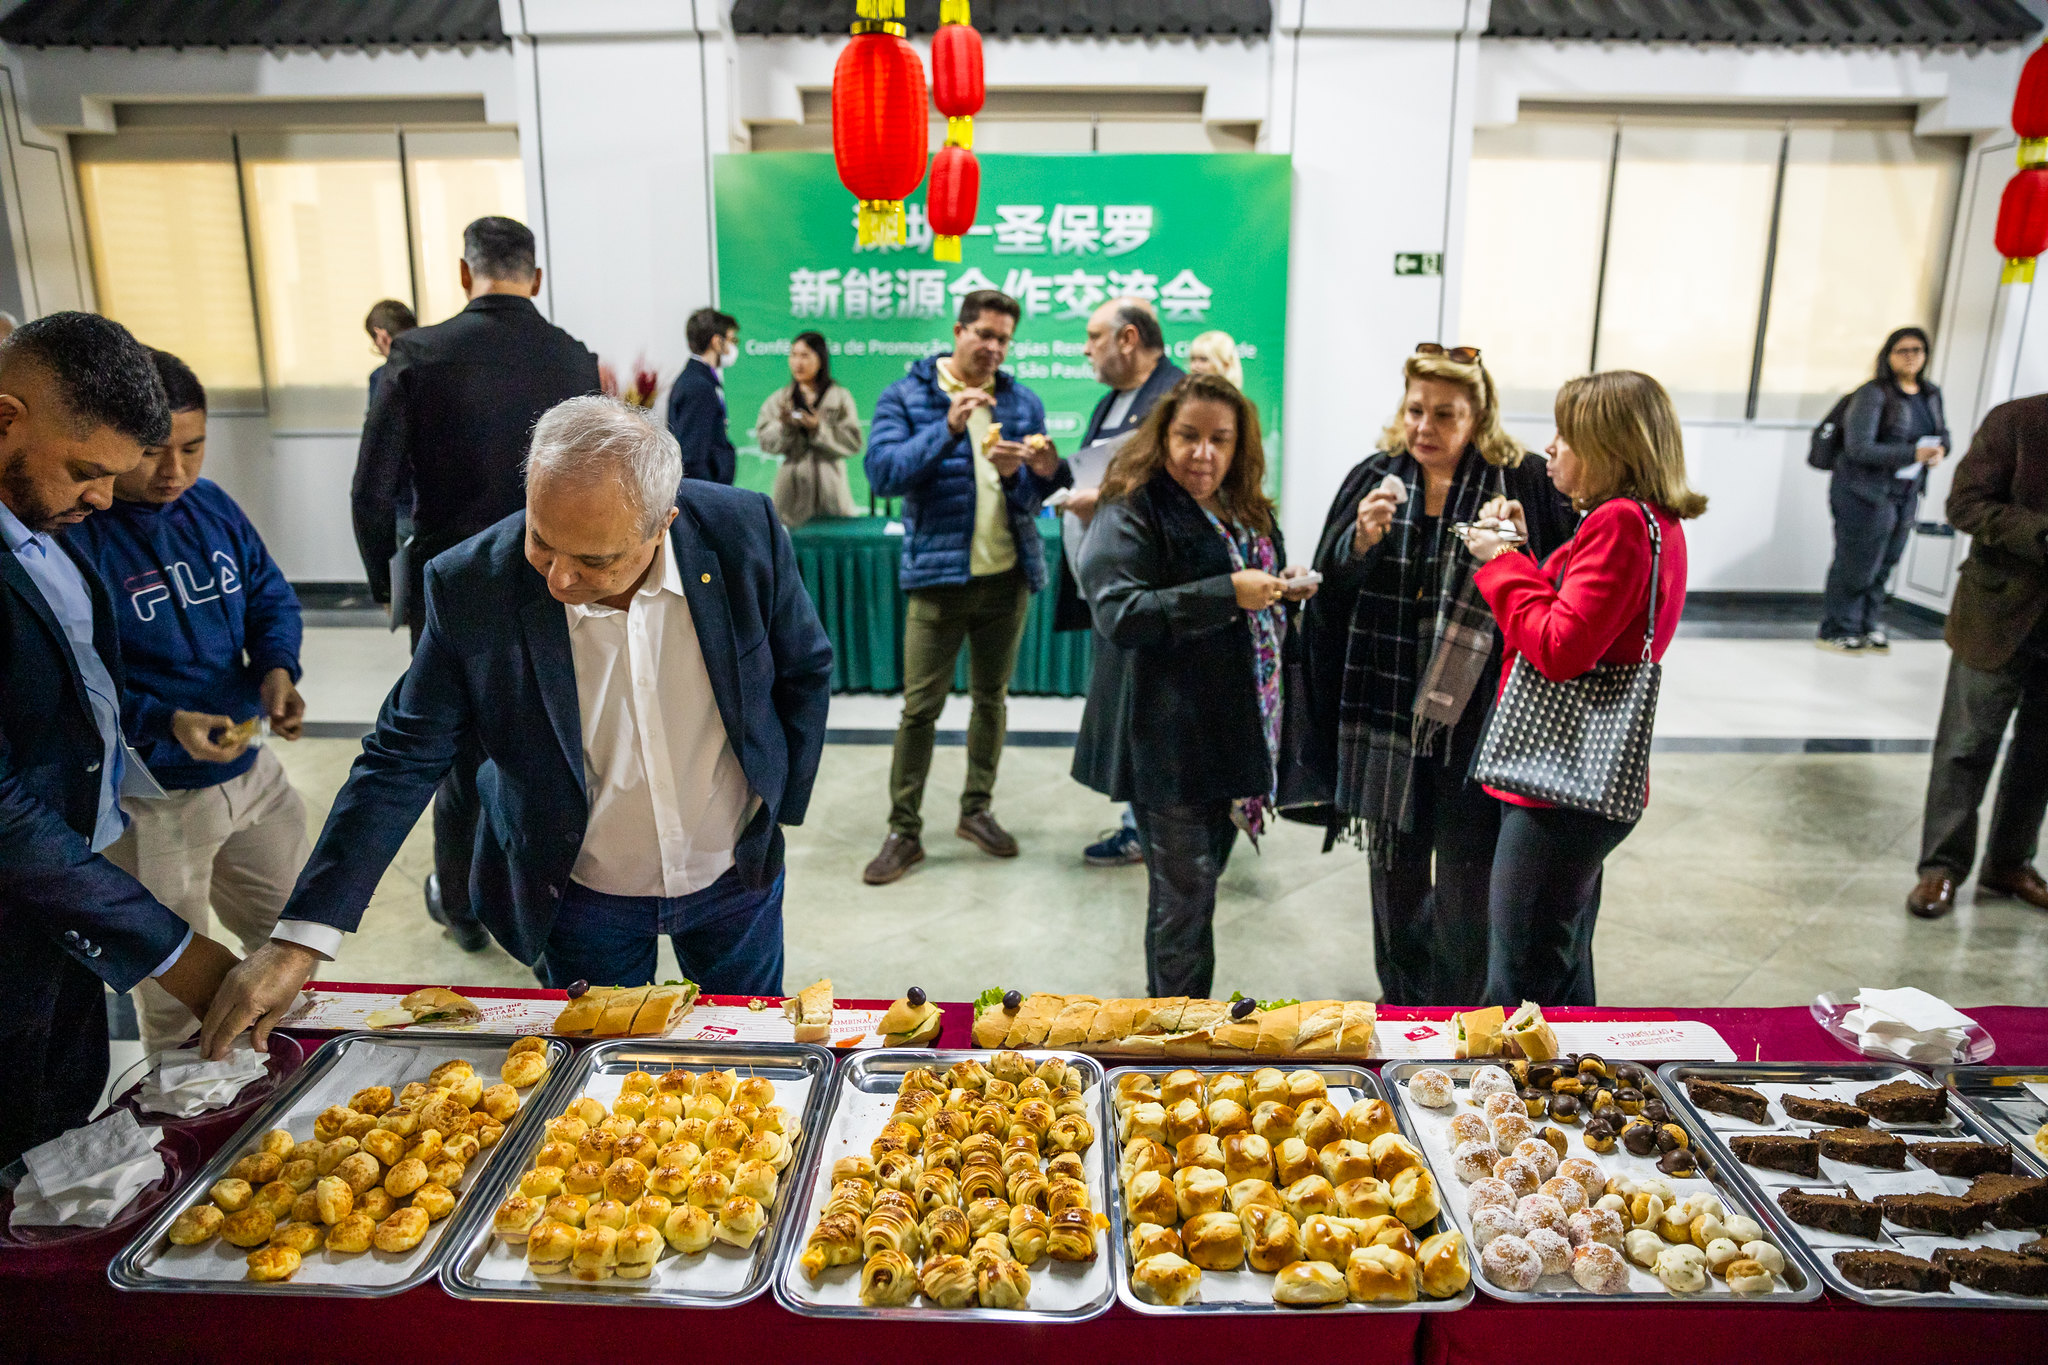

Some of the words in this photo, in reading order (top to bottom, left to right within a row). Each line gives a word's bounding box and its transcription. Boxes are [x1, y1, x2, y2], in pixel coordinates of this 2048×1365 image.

[843, 339, 866, 356] de
[1016, 361, 1049, 379] São
[124, 550, 242, 622] FILA
